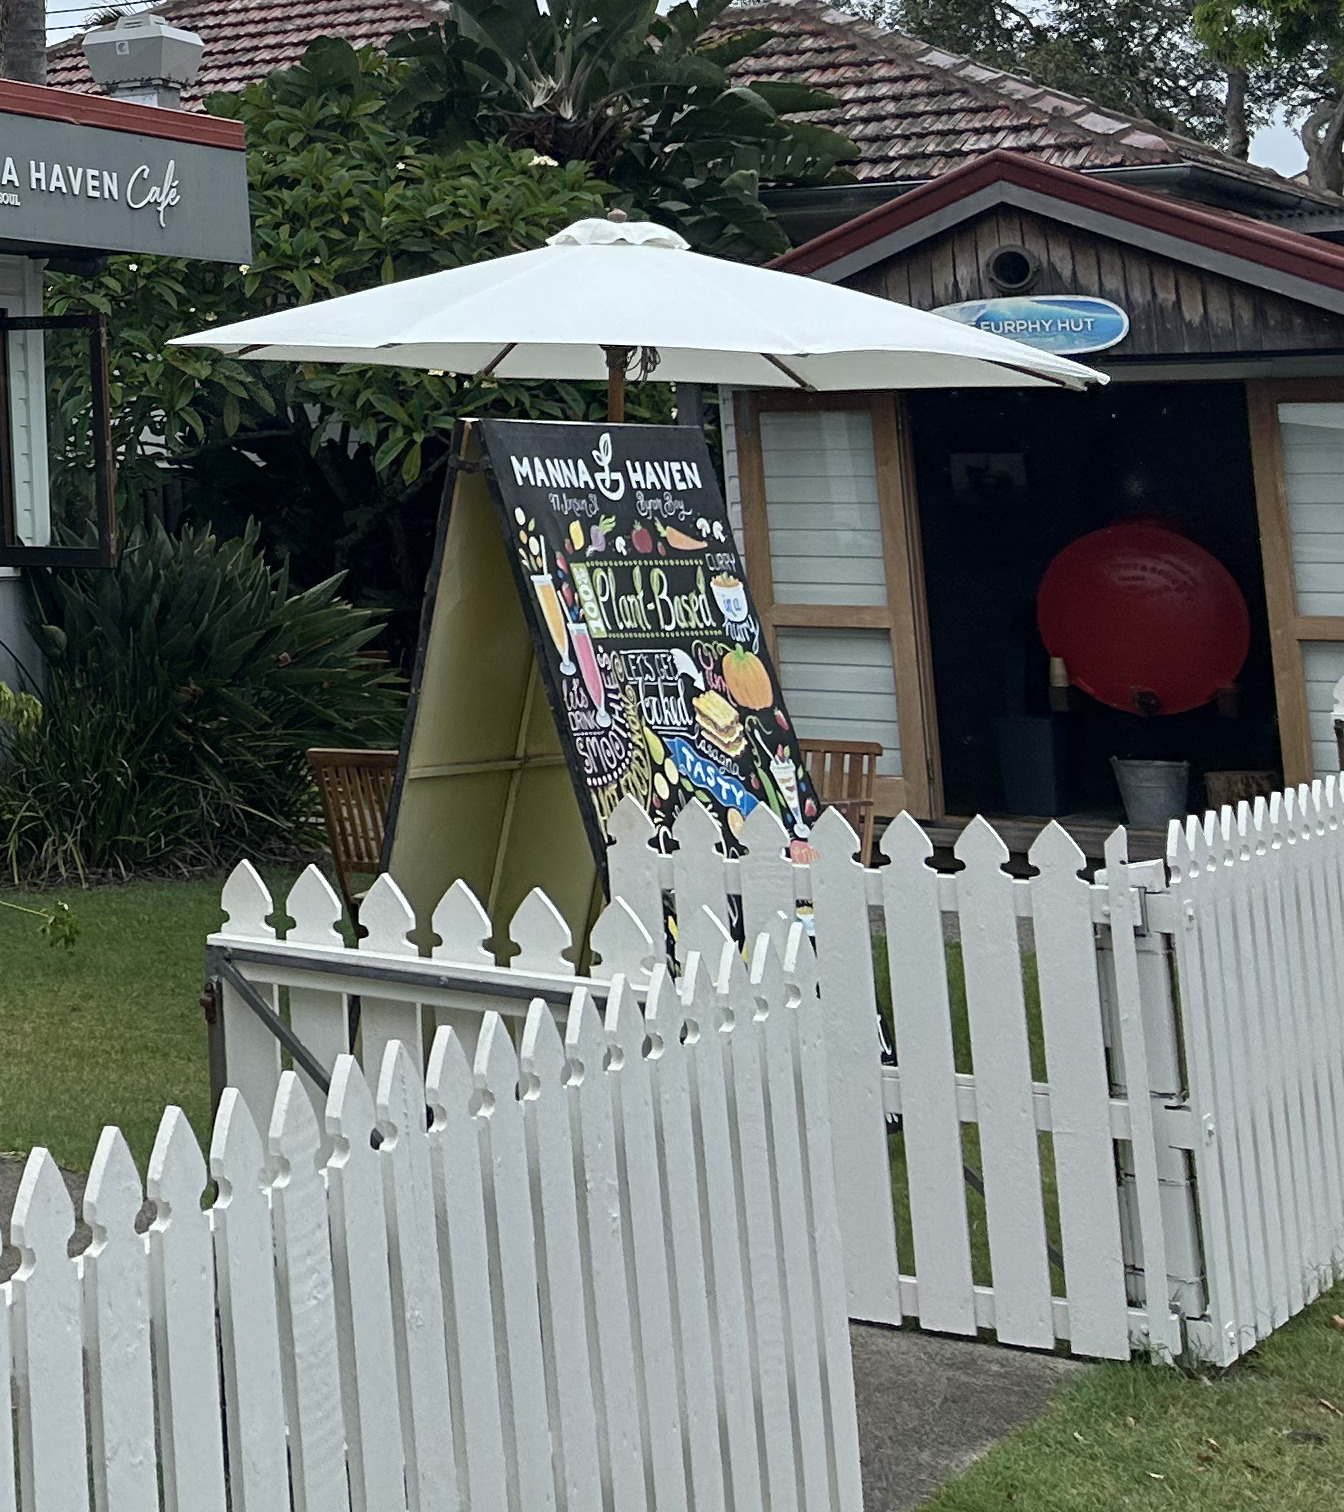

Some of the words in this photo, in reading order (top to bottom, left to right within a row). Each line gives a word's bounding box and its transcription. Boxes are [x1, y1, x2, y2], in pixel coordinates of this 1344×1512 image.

[28, 160, 120, 202] HAVEN
[124, 159, 182, 229] Café
[980, 319, 1053, 335] FURPHY
[1057, 318, 1096, 332] HUT
[510, 455, 596, 489] MANNA
[625, 459, 703, 490] HAVEN
[635, 490, 667, 520] Byron
[662, 491, 693, 521] Bay
[704, 553, 736, 572] CURRY
[592, 565, 717, 632] Plant-Based
[681, 746, 744, 806] TASTY
